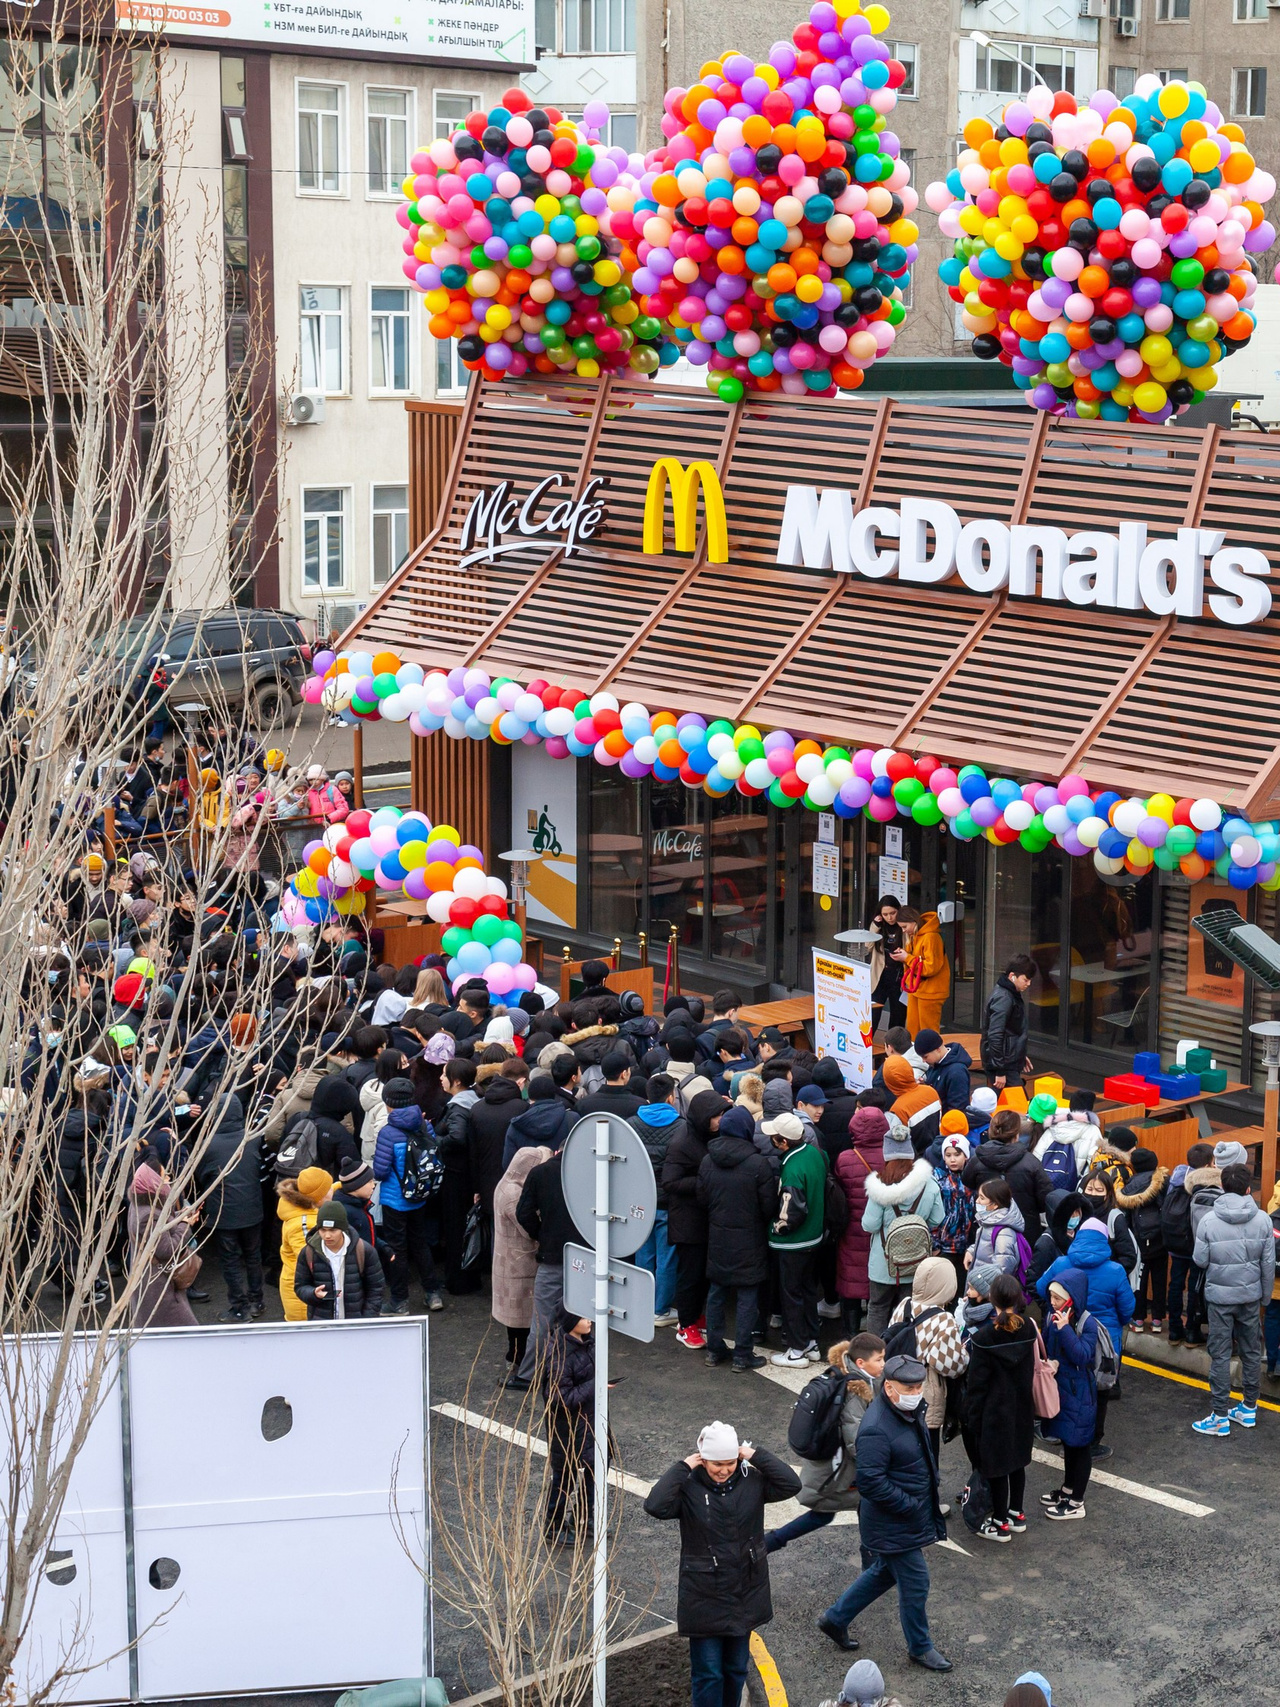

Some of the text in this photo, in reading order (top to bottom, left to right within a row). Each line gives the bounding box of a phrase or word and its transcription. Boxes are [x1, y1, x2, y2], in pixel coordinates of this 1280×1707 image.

[167, 8, 187, 20] 700
[189, 11, 203, 22] 03
[205, 12, 219, 24] 03
[274, 3, 362, 20] ҰБТ-ға ДАЙЫНДЫҚ
[274, 20, 409, 42] НЗМ мен БИЛ-ге ДАЙЫНДЫҚ
[437, 18, 500, 33] ЖЕКЕ ПӘНДЕР
[437, 36, 486, 48] АҒЫЛШЫН
[459, 473, 611, 568] McCafé
[776, 485, 1273, 625] McDonald's
[653, 830, 702, 863] McCafé
[838, 1036, 845, 1049] 2
